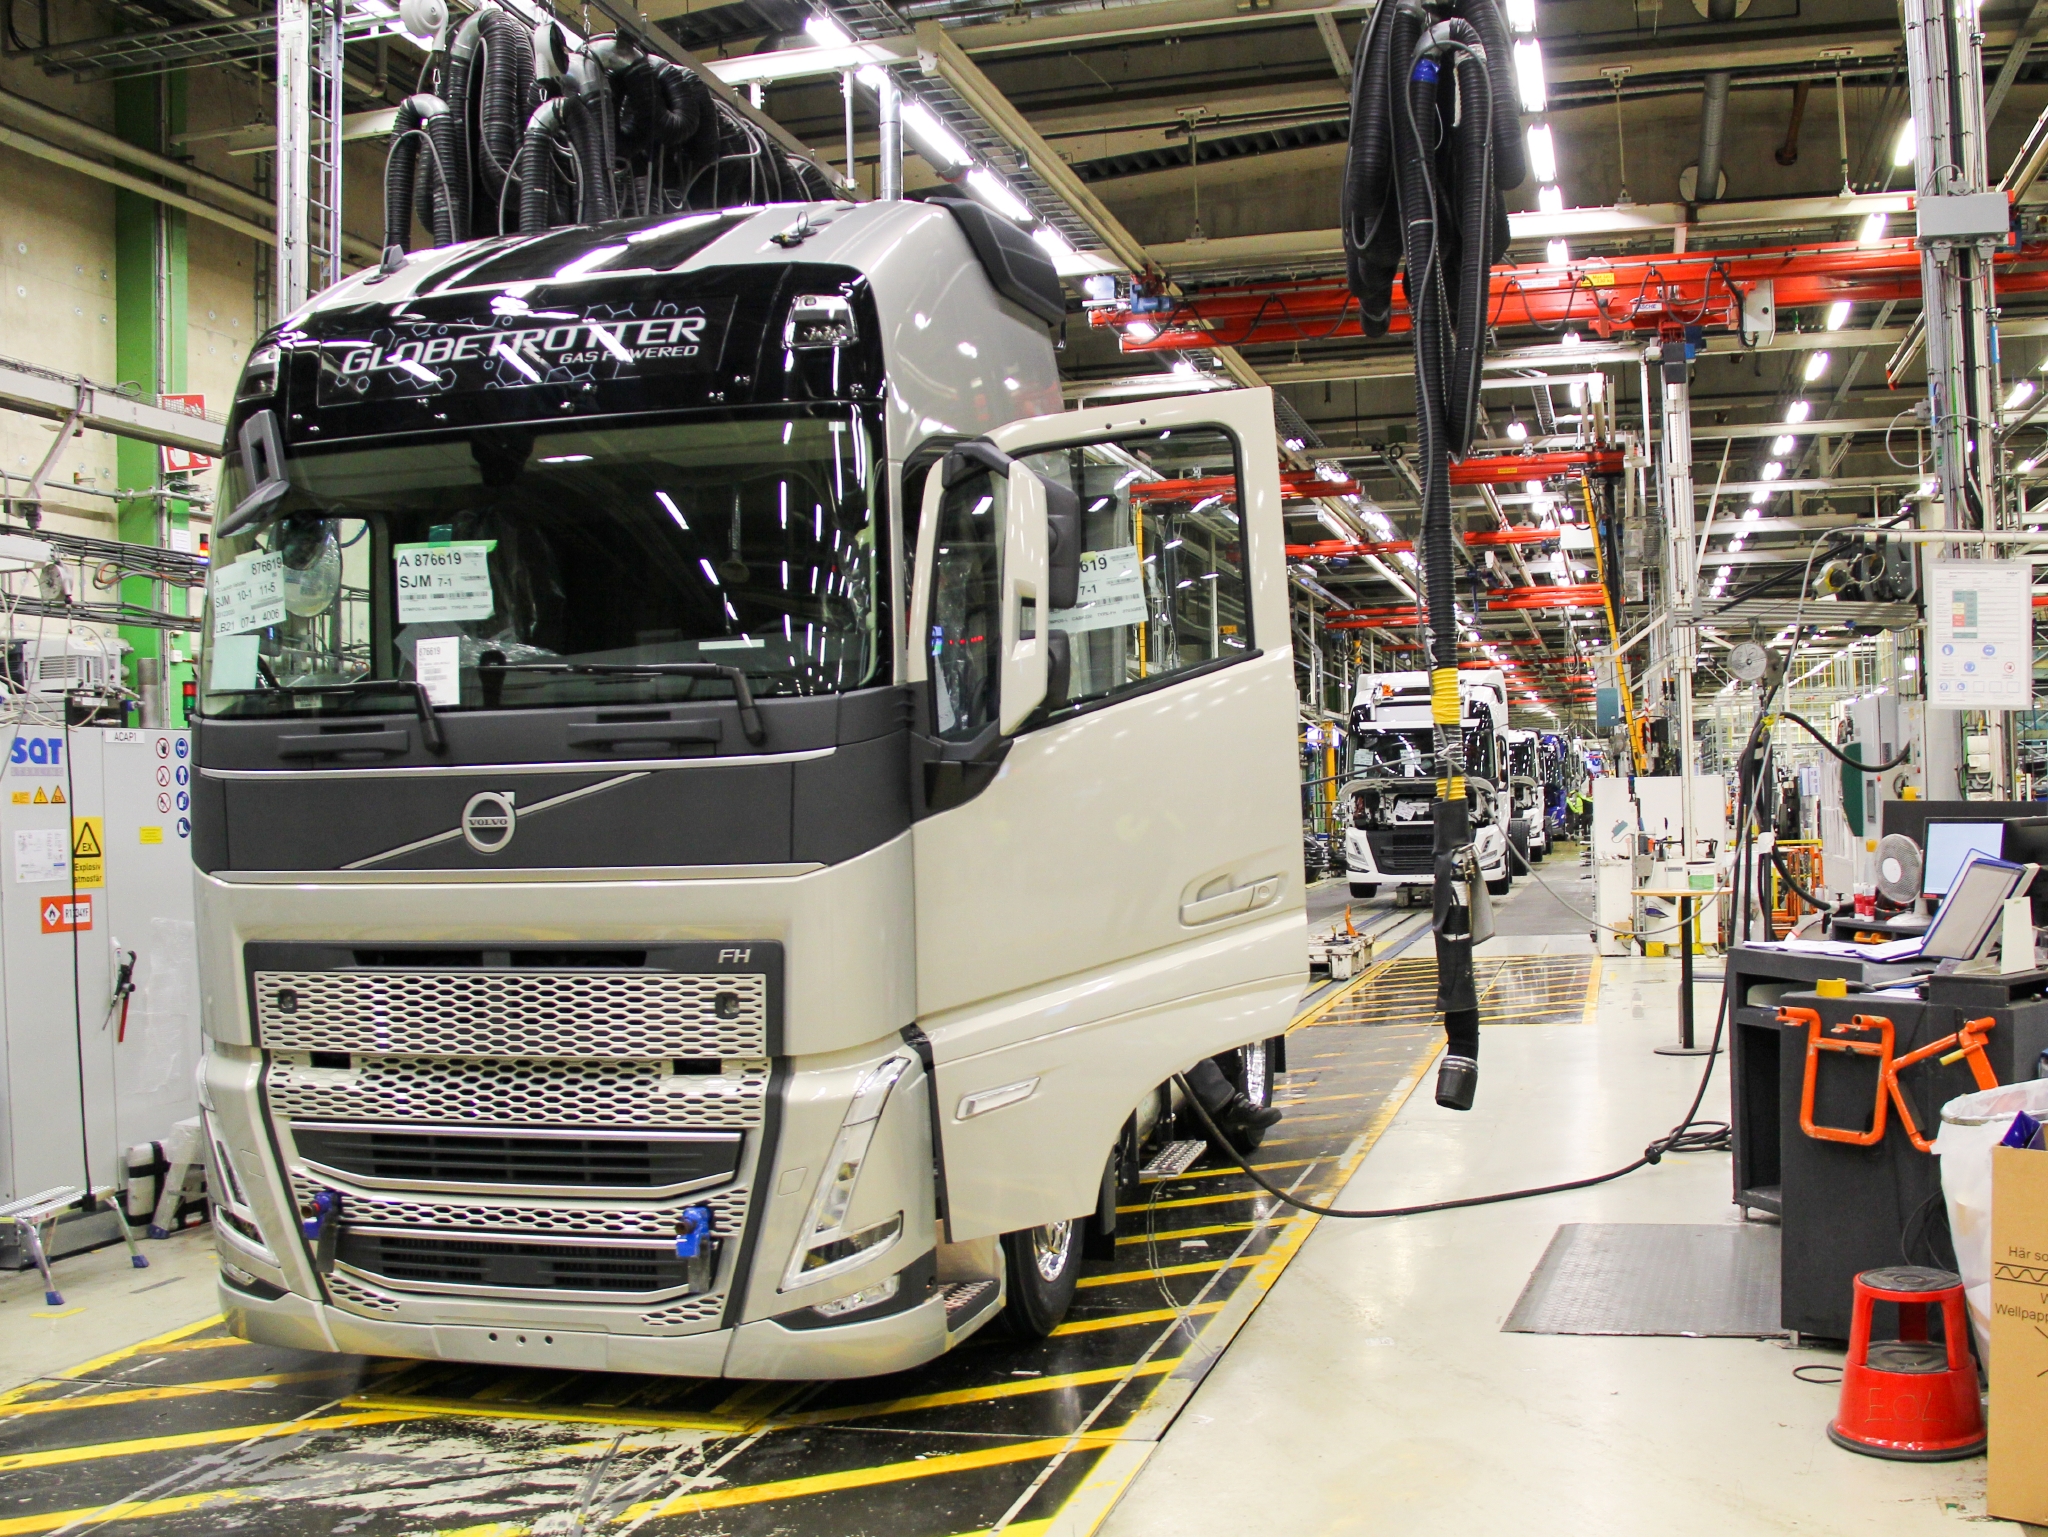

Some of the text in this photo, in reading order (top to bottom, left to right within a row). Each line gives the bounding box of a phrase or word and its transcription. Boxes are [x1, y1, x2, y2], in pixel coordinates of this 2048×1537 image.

[341, 317, 706, 375] GLOBETROTTER
[559, 345, 699, 365] GAS PWERED
[251, 557, 282, 575] 876619
[399, 555, 410, 567] A
[414, 552, 462, 567] 876619
[399, 575, 432, 588] SJM
[437, 577, 452, 587] 7-1
[216, 595, 231, 608] SJM
[237, 589, 252, 601] 10-1
[260, 582, 276, 595] 11-5
[1080, 584, 1097, 596] 7-1
[240, 615, 256, 628] 07-4
[114, 731, 137, 742] ACAP1
[469, 818, 508, 826] VOLVO
[82, 842, 93, 852] EX
[74, 863, 101, 873] Explosiv
[65, 907, 89, 918] R134YF
[718, 949, 751, 963] FH
[2008, 1246, 2031, 1259] Här
[1865, 1388, 1944, 1423] EOL
